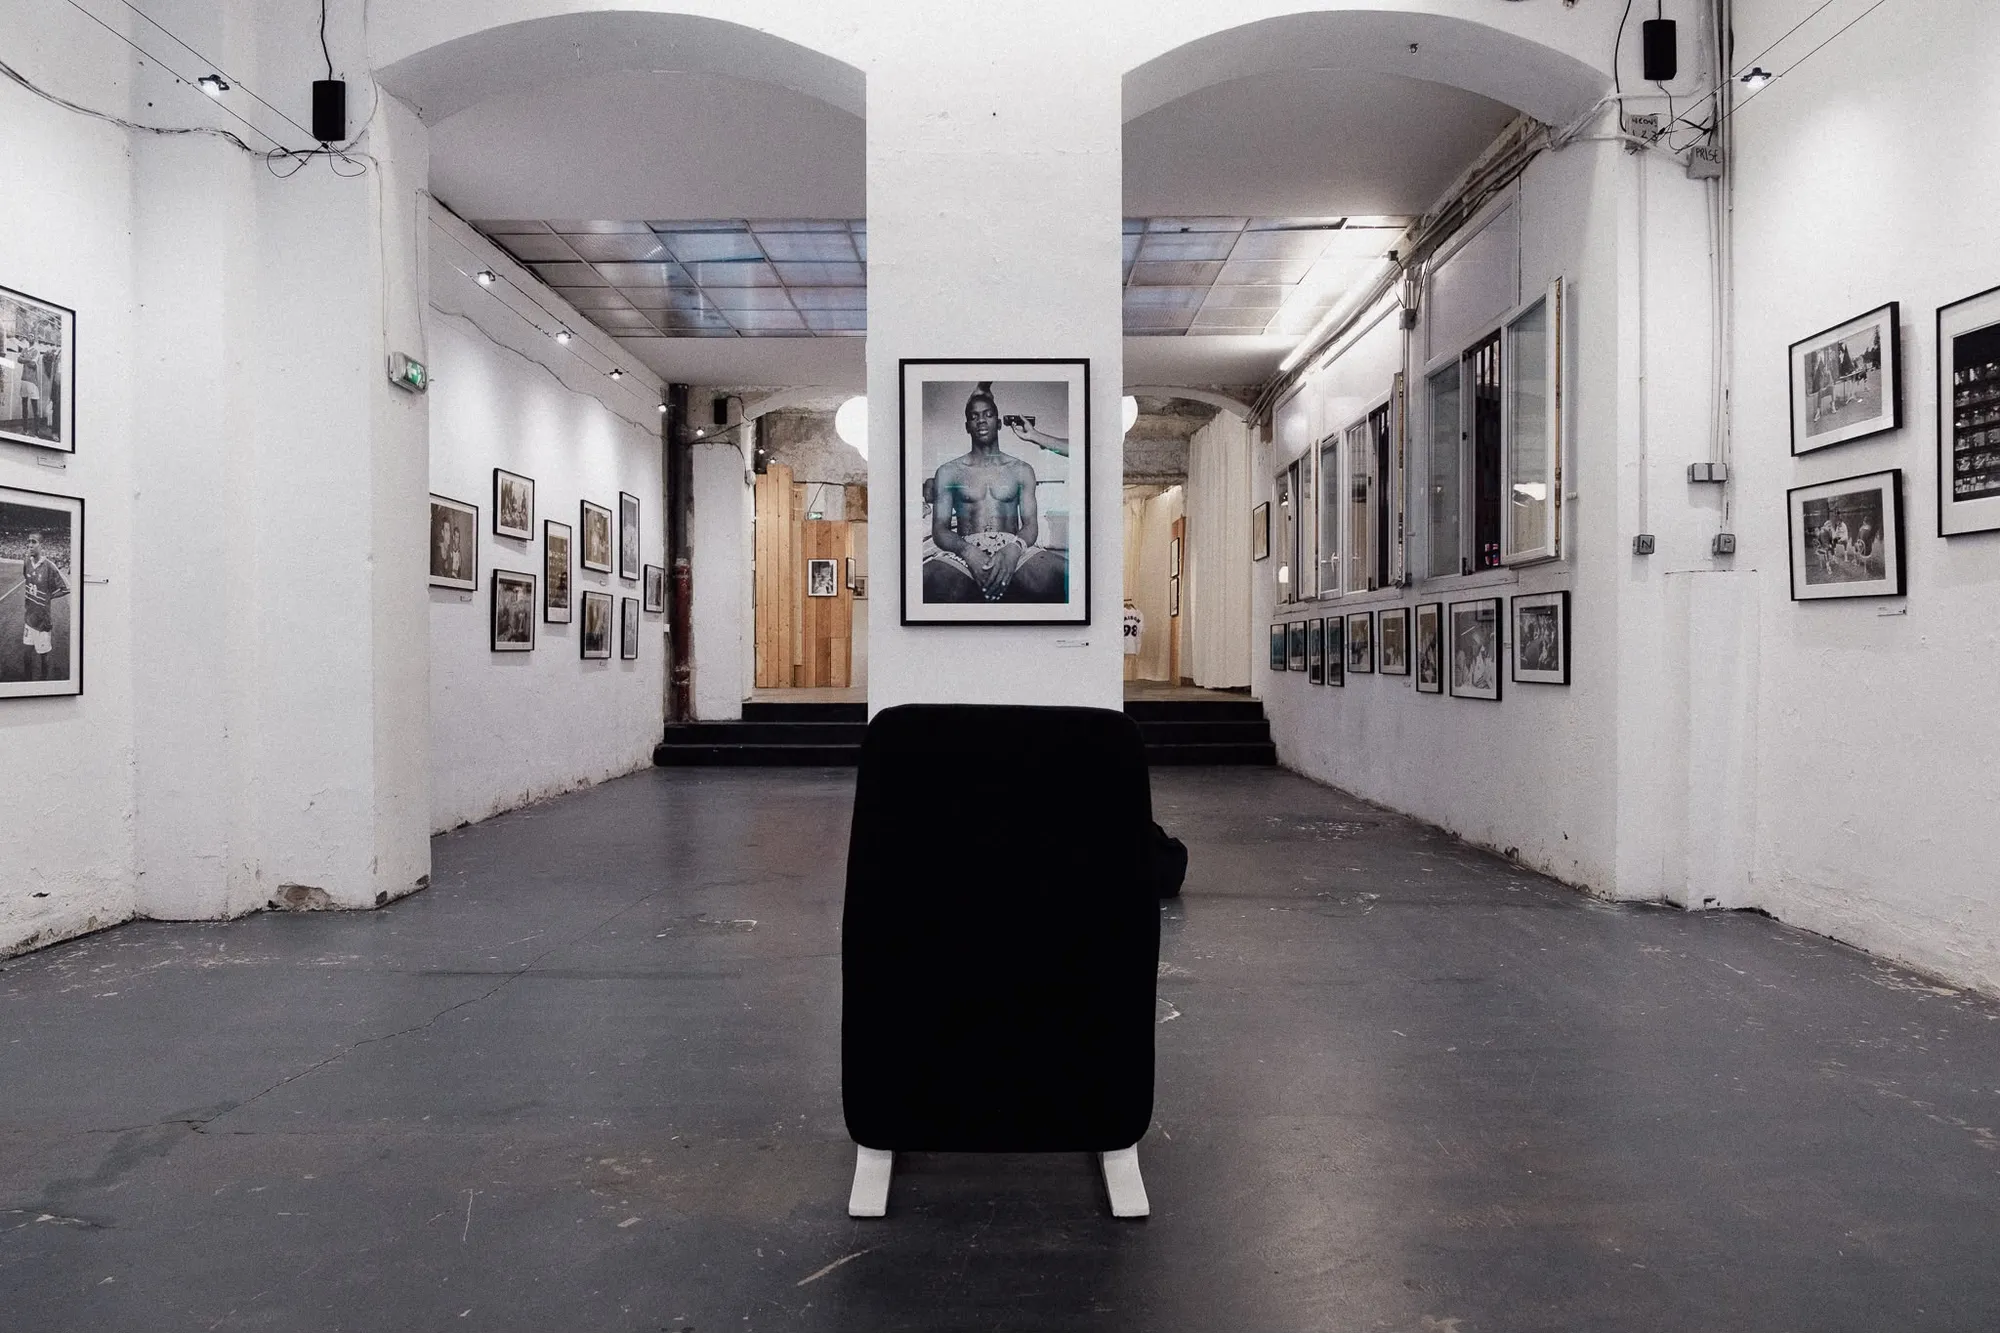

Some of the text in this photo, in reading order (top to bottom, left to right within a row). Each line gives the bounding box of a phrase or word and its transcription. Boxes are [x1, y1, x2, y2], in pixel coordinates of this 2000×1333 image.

[1695, 147, 1721, 164] PRISE
[1641, 538, 1653, 549] N
[1124, 624, 1138, 637] 98
